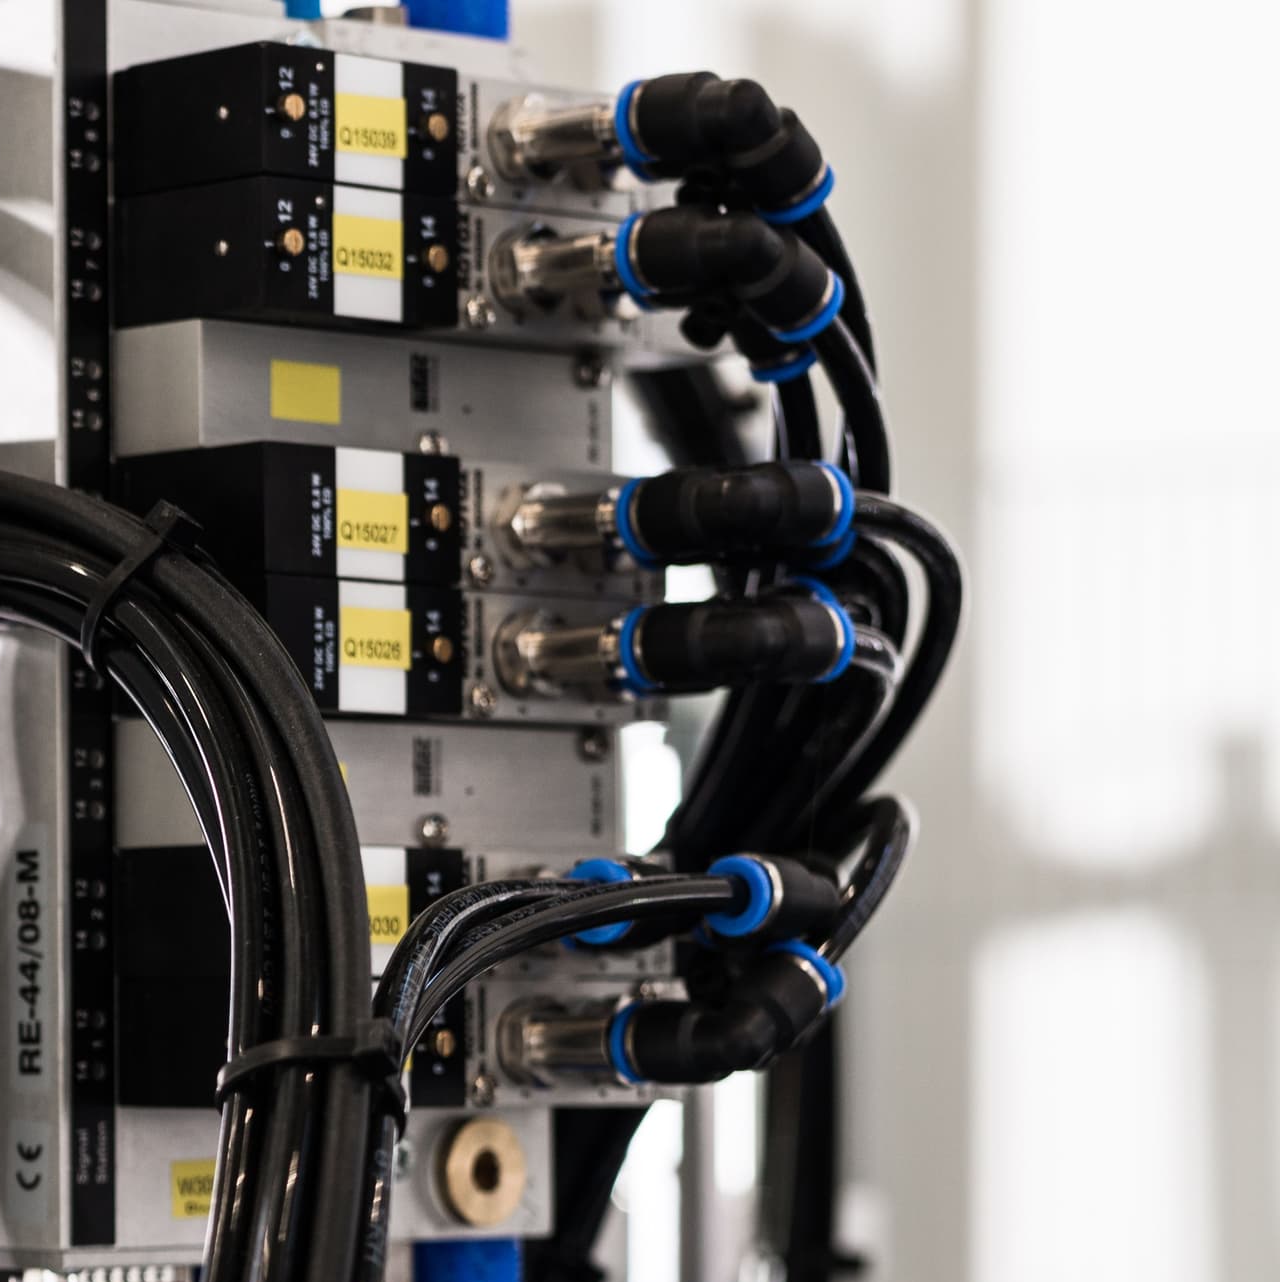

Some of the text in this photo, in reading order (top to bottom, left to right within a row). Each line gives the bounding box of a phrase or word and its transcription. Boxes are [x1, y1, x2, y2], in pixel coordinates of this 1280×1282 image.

[278, 66, 294, 91] 12
[339, 126, 398, 149] Q15039
[277, 199, 293, 223] 12
[336, 246, 395, 271] Q15032
[340, 521, 399, 544] Q15027
[343, 635, 402, 660] Q15026
[15, 849, 42, 1076] RE-44/08-M
[75, 1128, 92, 1185] Signal
[95, 1119, 109, 1185] Station
